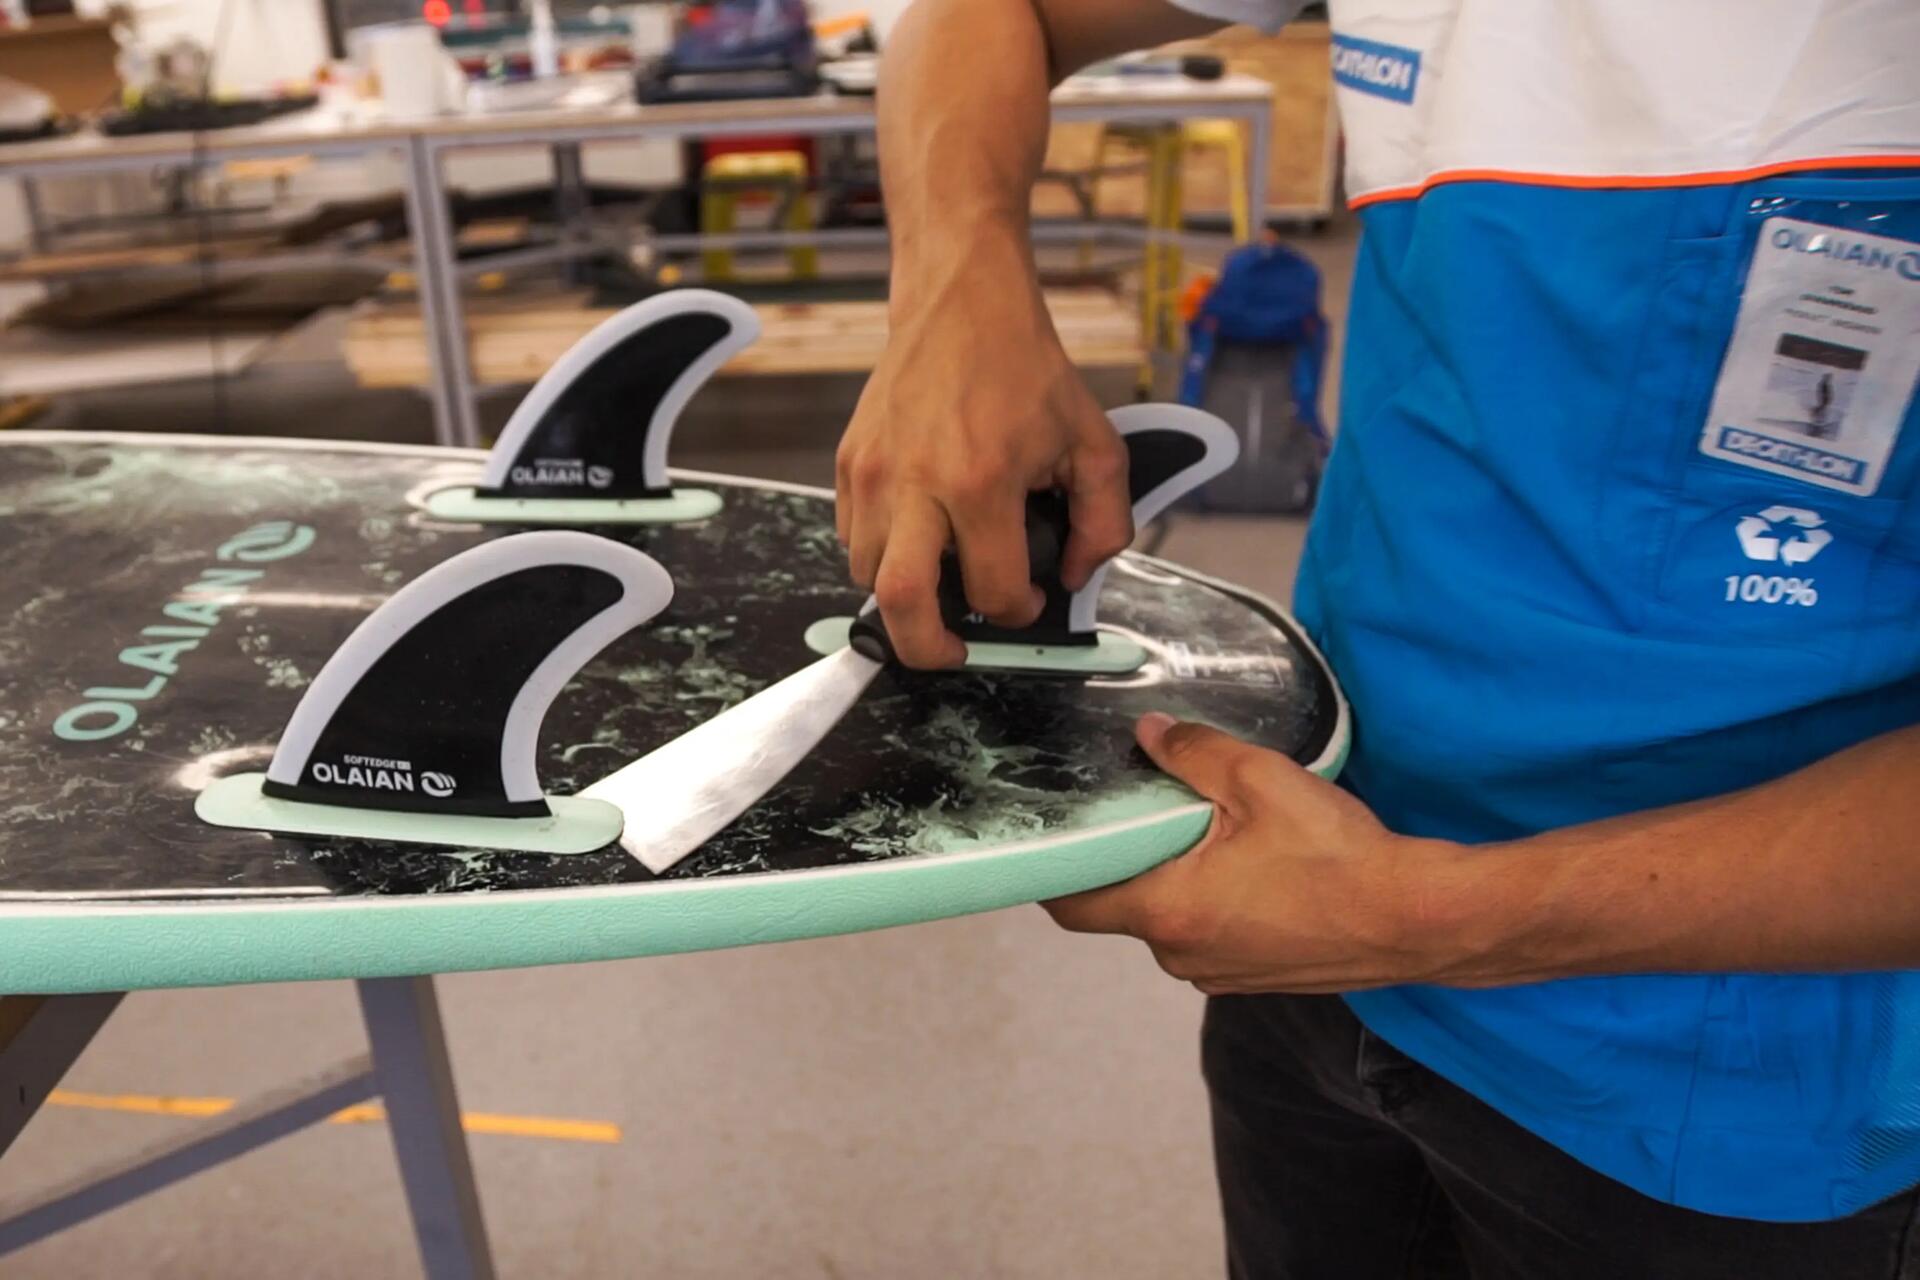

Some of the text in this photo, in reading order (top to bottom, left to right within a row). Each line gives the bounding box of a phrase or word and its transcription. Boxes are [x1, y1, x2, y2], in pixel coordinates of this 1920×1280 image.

[1725, 430, 1859, 479] DECATHLON
[511, 465, 585, 486] OLAIAN
[1724, 574, 1819, 607] 100%
[53, 568, 265, 741] OLAIAN
[312, 762, 415, 792] OLAIAN
